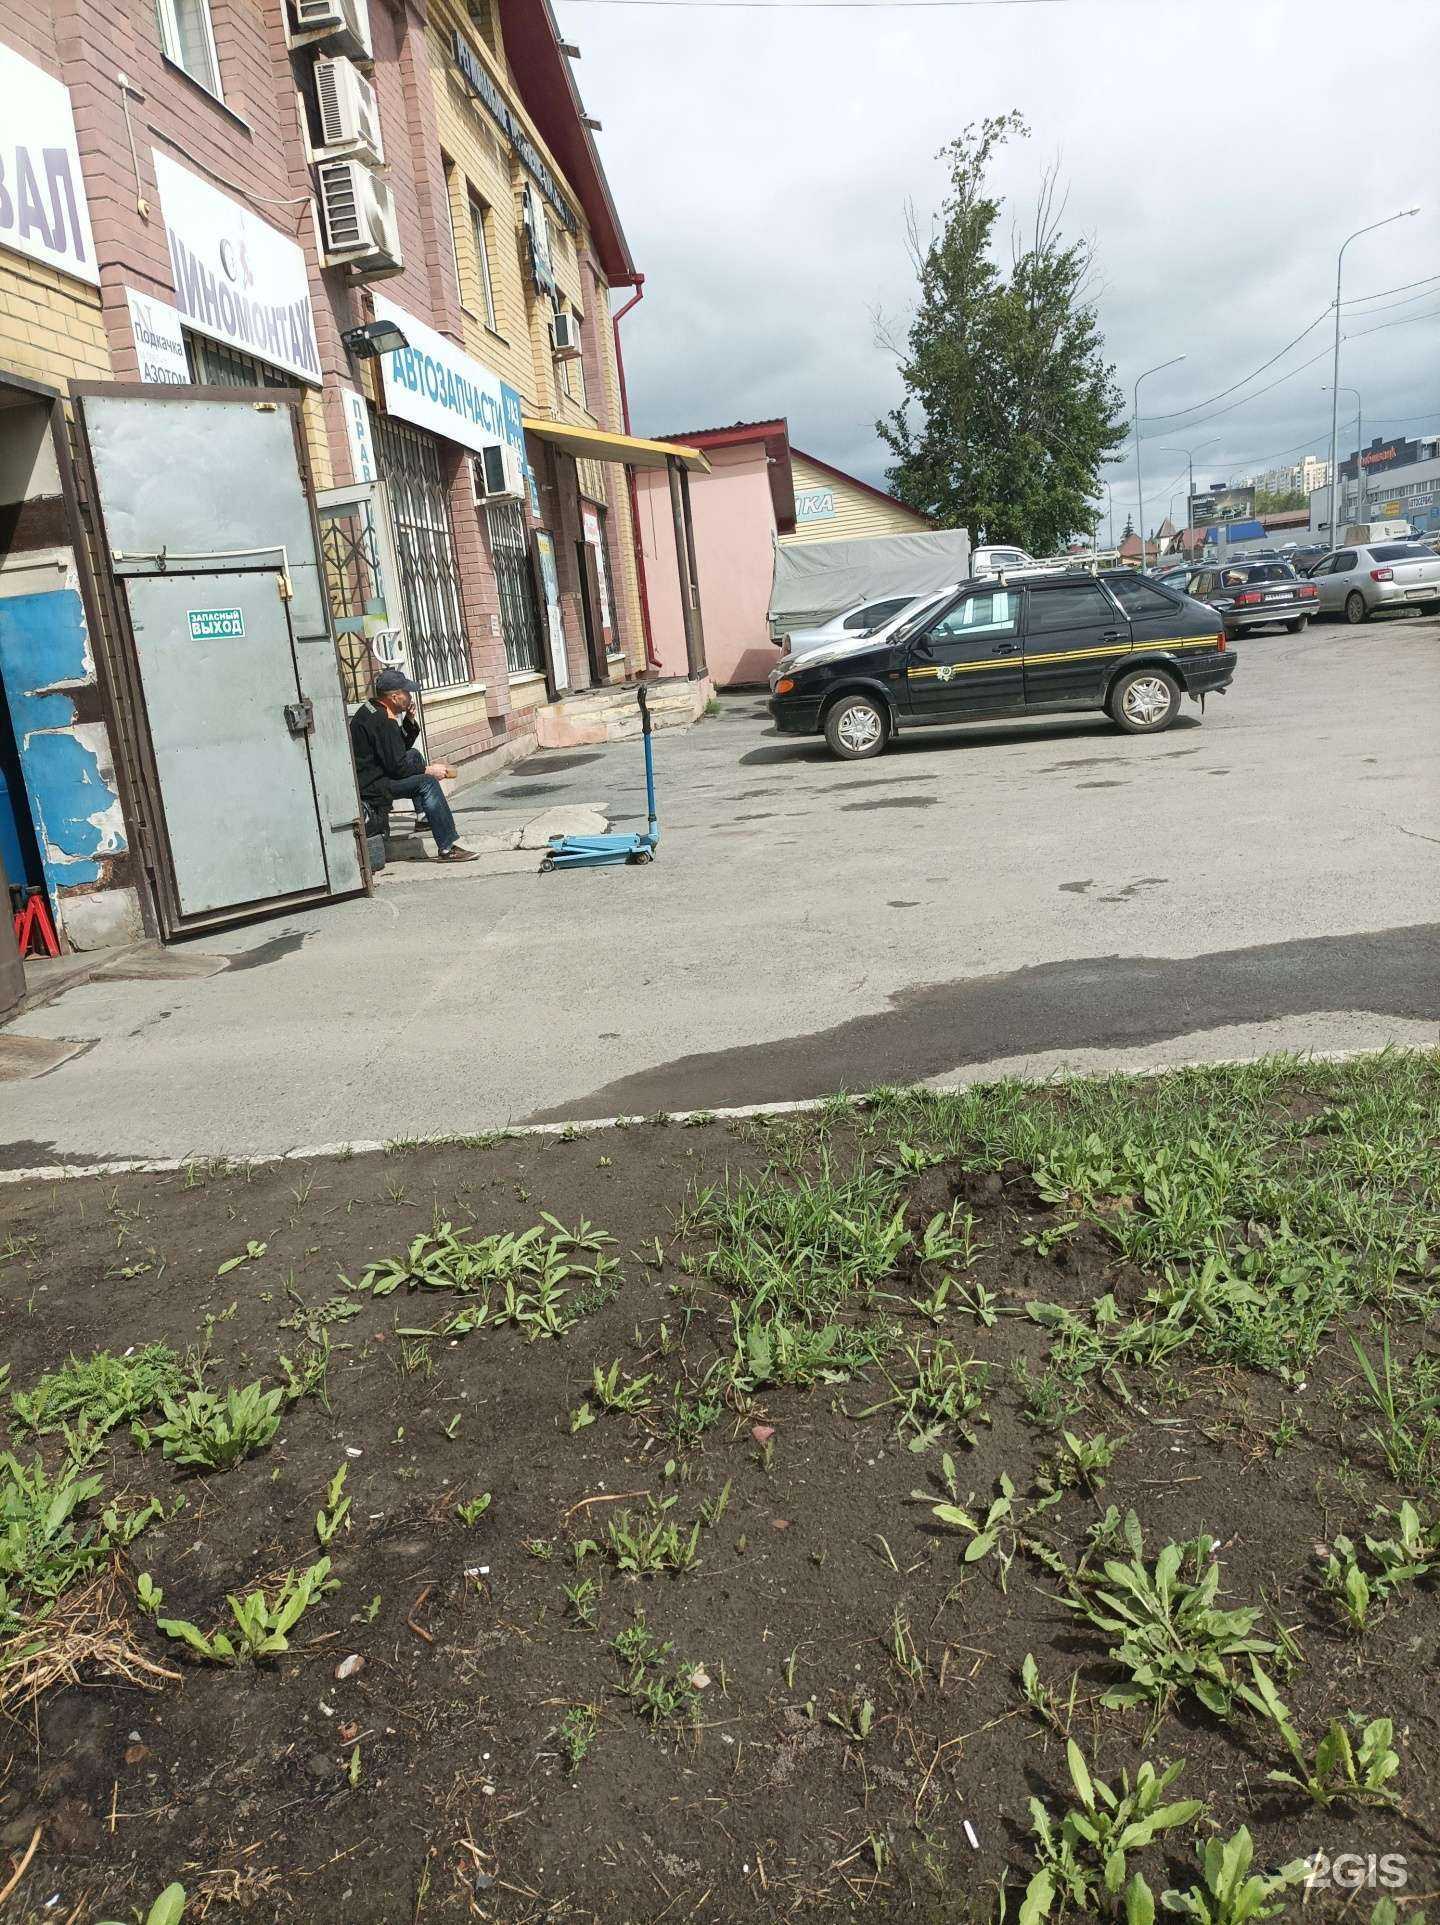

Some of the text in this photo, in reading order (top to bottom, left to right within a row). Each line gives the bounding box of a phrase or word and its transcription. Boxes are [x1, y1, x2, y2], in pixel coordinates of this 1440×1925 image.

[134, 321, 183, 357] Подкачка
[393, 346, 506, 441] АВТОЗАПЧАСТИ
[190, 610, 240, 622] ЗАПАСНЫЙ
[191, 620, 243, 635] ВЫХОД
